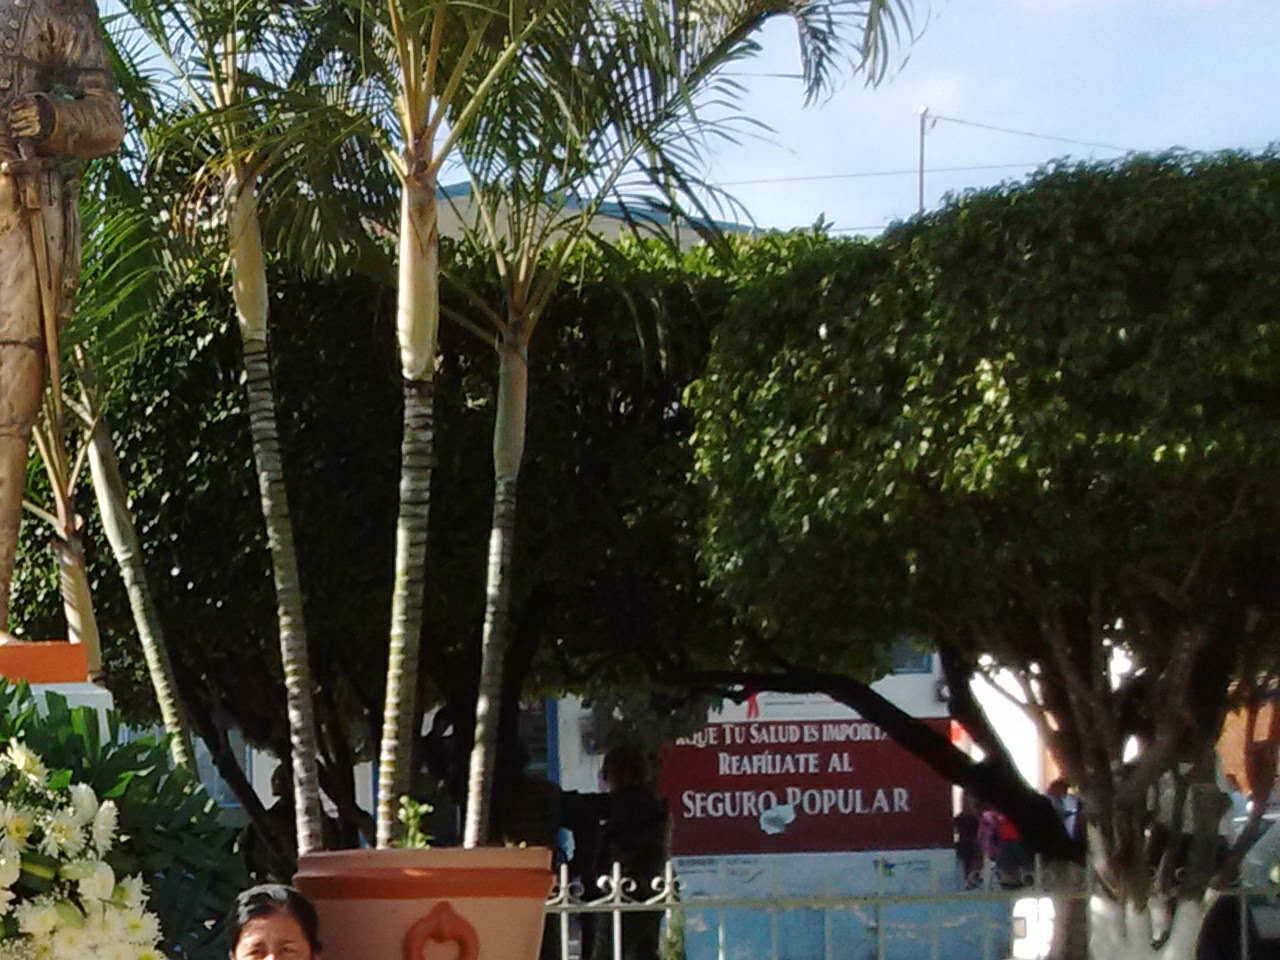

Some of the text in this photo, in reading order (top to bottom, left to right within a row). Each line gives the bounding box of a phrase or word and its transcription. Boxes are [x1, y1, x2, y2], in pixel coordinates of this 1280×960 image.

[723, 723, 746, 745] TU
[750, 723, 800, 744] SALUD
[803, 724, 820, 743] ES
[821, 722, 888, 742] IMPORT
[827, 751, 854, 773] AL
[682, 786, 910, 819] SEGURO POPULAR
